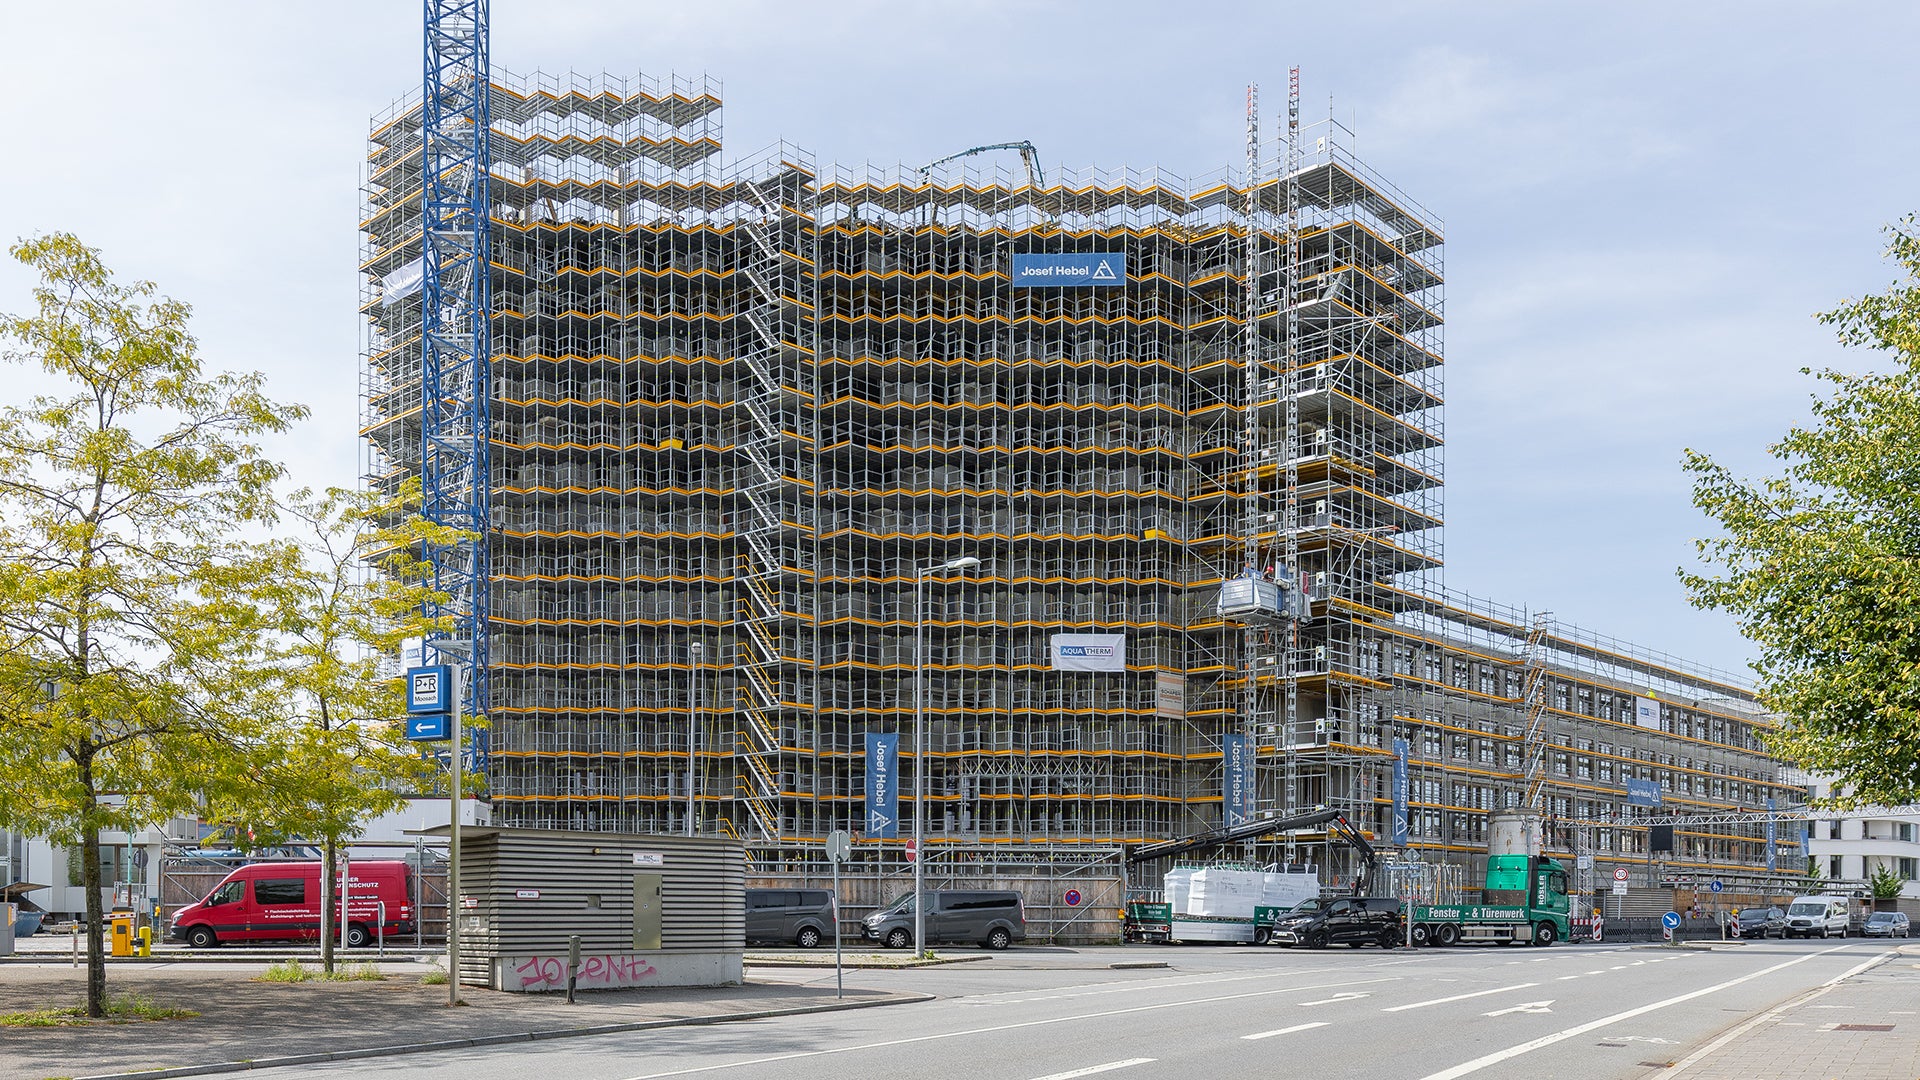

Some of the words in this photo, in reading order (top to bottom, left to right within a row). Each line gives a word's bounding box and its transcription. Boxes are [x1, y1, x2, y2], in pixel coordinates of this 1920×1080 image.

[1021, 265, 1053, 276] Josef
[1055, 265, 1089, 276] Hebel
[1062, 647, 1083, 655] AQUA
[415, 677, 436, 691] P+R
[876, 741, 887, 772] Josef
[1232, 741, 1242, 772] Josef
[876, 774, 886, 807] Hebel
[1232, 774, 1242, 807] Hebel
[1617, 870, 1625, 878] 30
[1428, 907, 1460, 919] Fenster
[1472, 907, 1478, 919] &
[1481, 907, 1524, 919] Türenwerk
